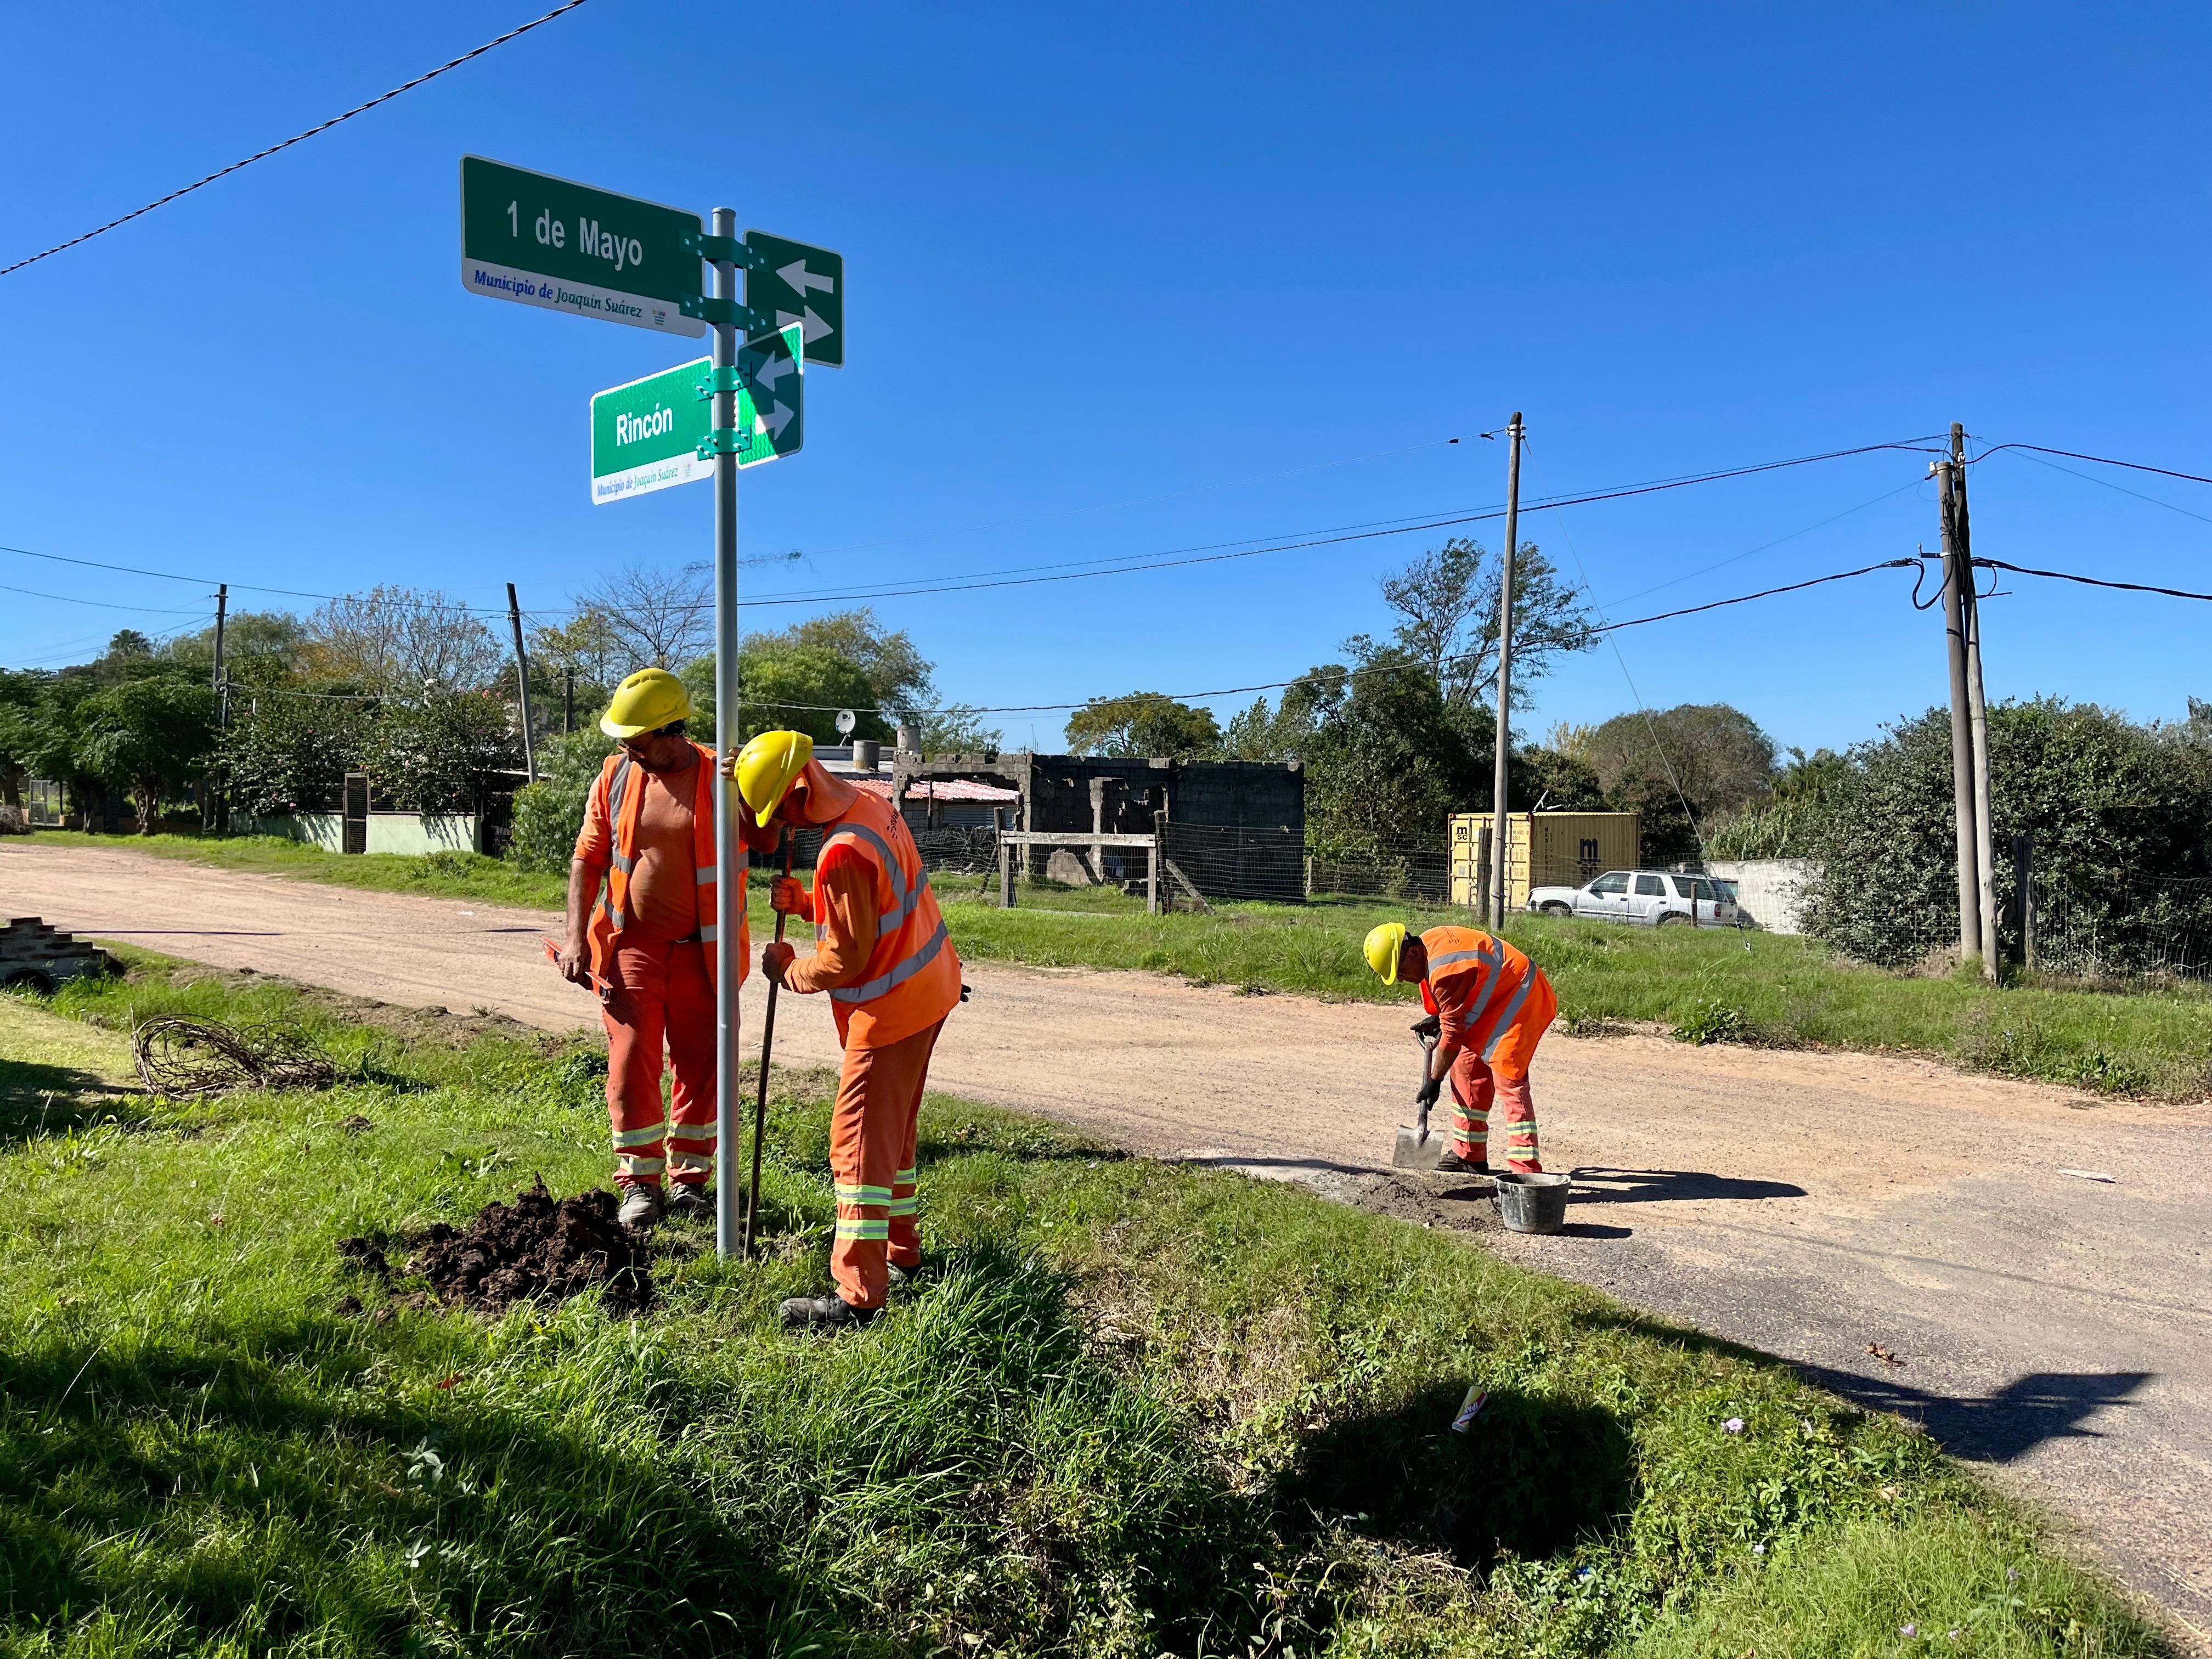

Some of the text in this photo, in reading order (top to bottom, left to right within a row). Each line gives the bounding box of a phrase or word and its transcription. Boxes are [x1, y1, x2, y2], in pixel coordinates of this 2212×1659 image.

[507, 200, 642, 271] 1 de Mayo
[474, 269, 535, 297] Municipio
[539, 283, 553, 299] de
[605, 298, 642, 318] Suárez
[617, 402, 673, 447] Rincón
[597, 479, 624, 496] Municipio
[625, 476, 633, 489] de
